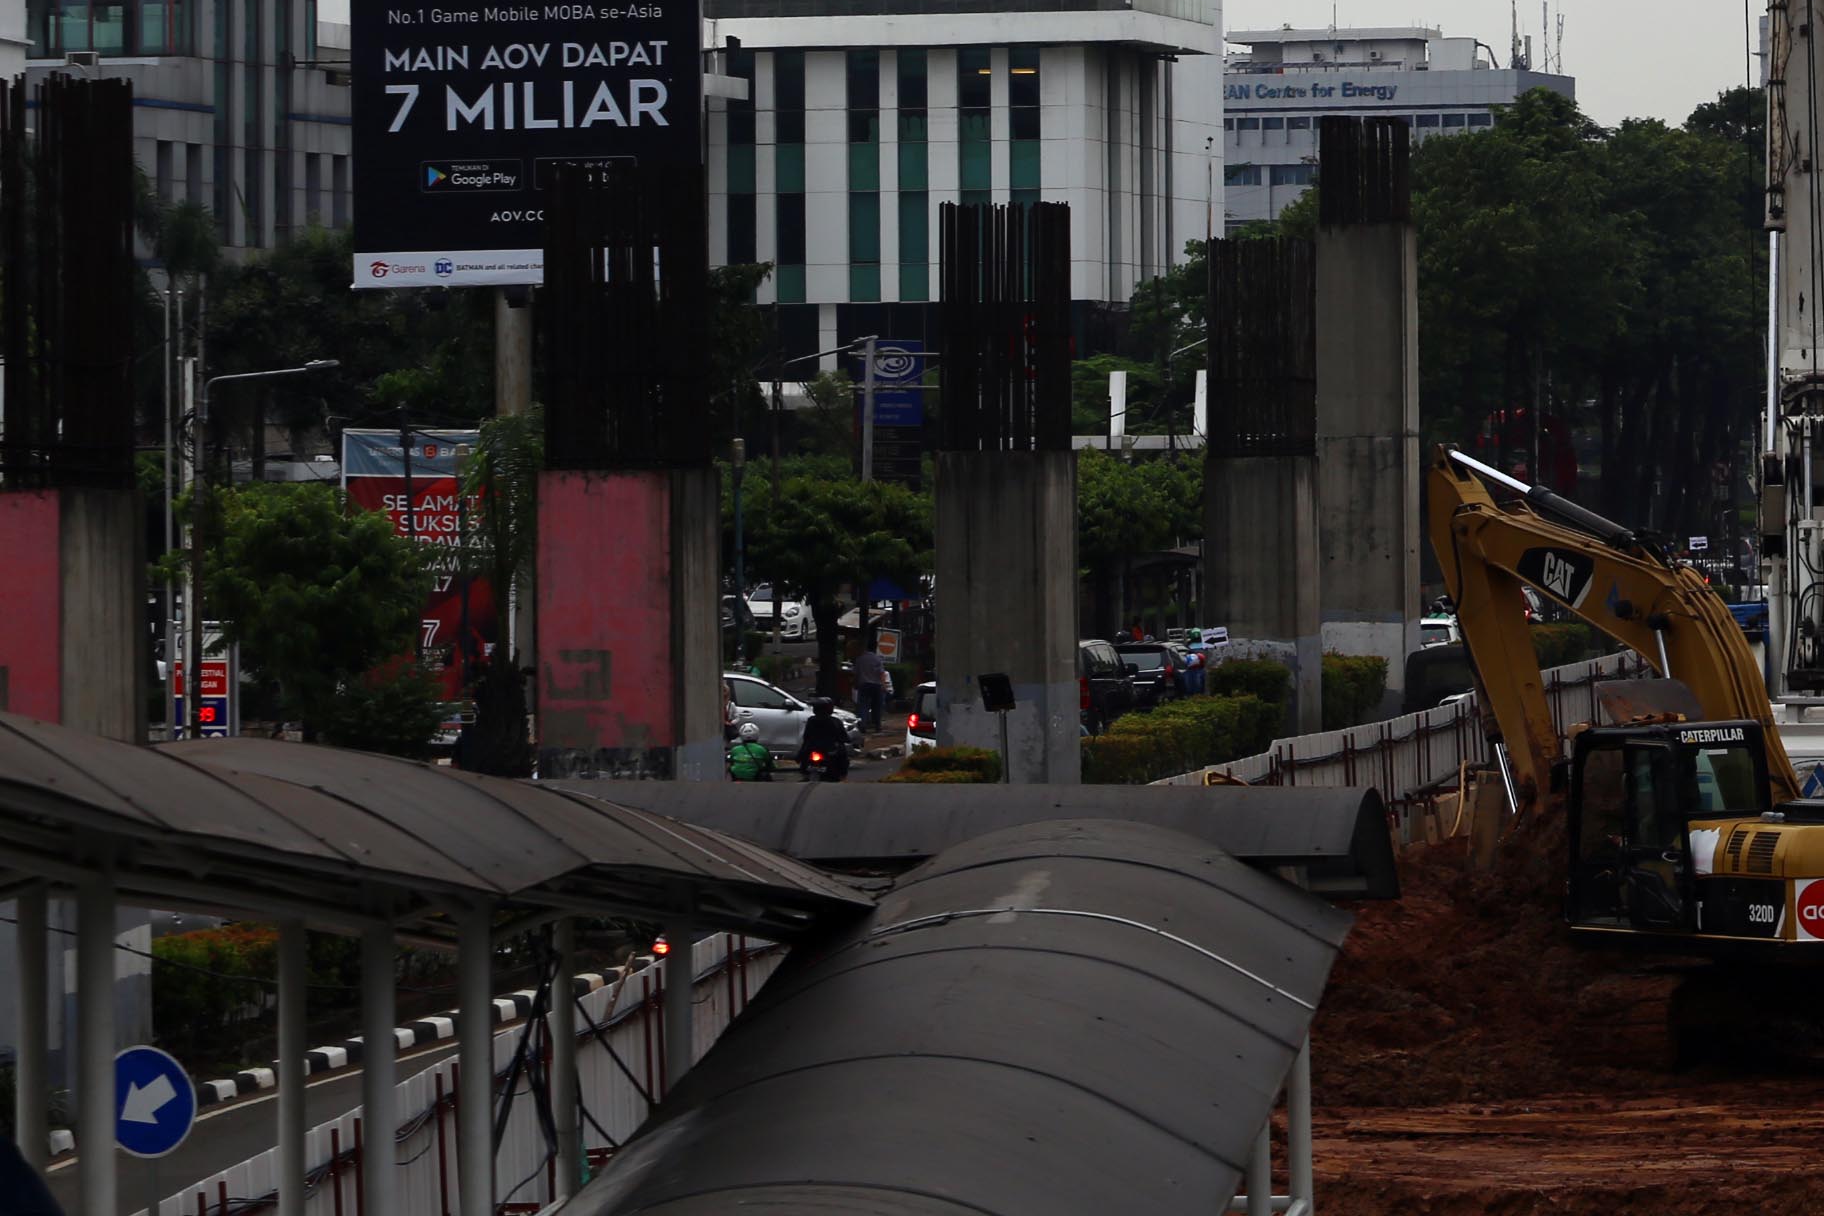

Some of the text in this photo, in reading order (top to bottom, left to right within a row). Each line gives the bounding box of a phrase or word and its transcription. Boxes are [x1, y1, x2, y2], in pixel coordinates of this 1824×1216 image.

[388, 3, 663, 24] No.1 Game Mobile MOBA se-Asia
[385, 40, 668, 72] MAIN AOV DAPAT
[1255, 83, 1306, 100] Centre
[1311, 82, 1335, 98] for
[1341, 81, 1397, 100] Energy
[385, 79, 670, 133] 7 MILIAR
[451, 171, 517, 188] Google Play
[391, 264, 426, 274] Garena
[435, 262, 452, 274] DC
[1542, 552, 1575, 599] CAT
[1680, 728, 1745, 744] CATERPILLAR
[1749, 904, 1775, 924] 320D
